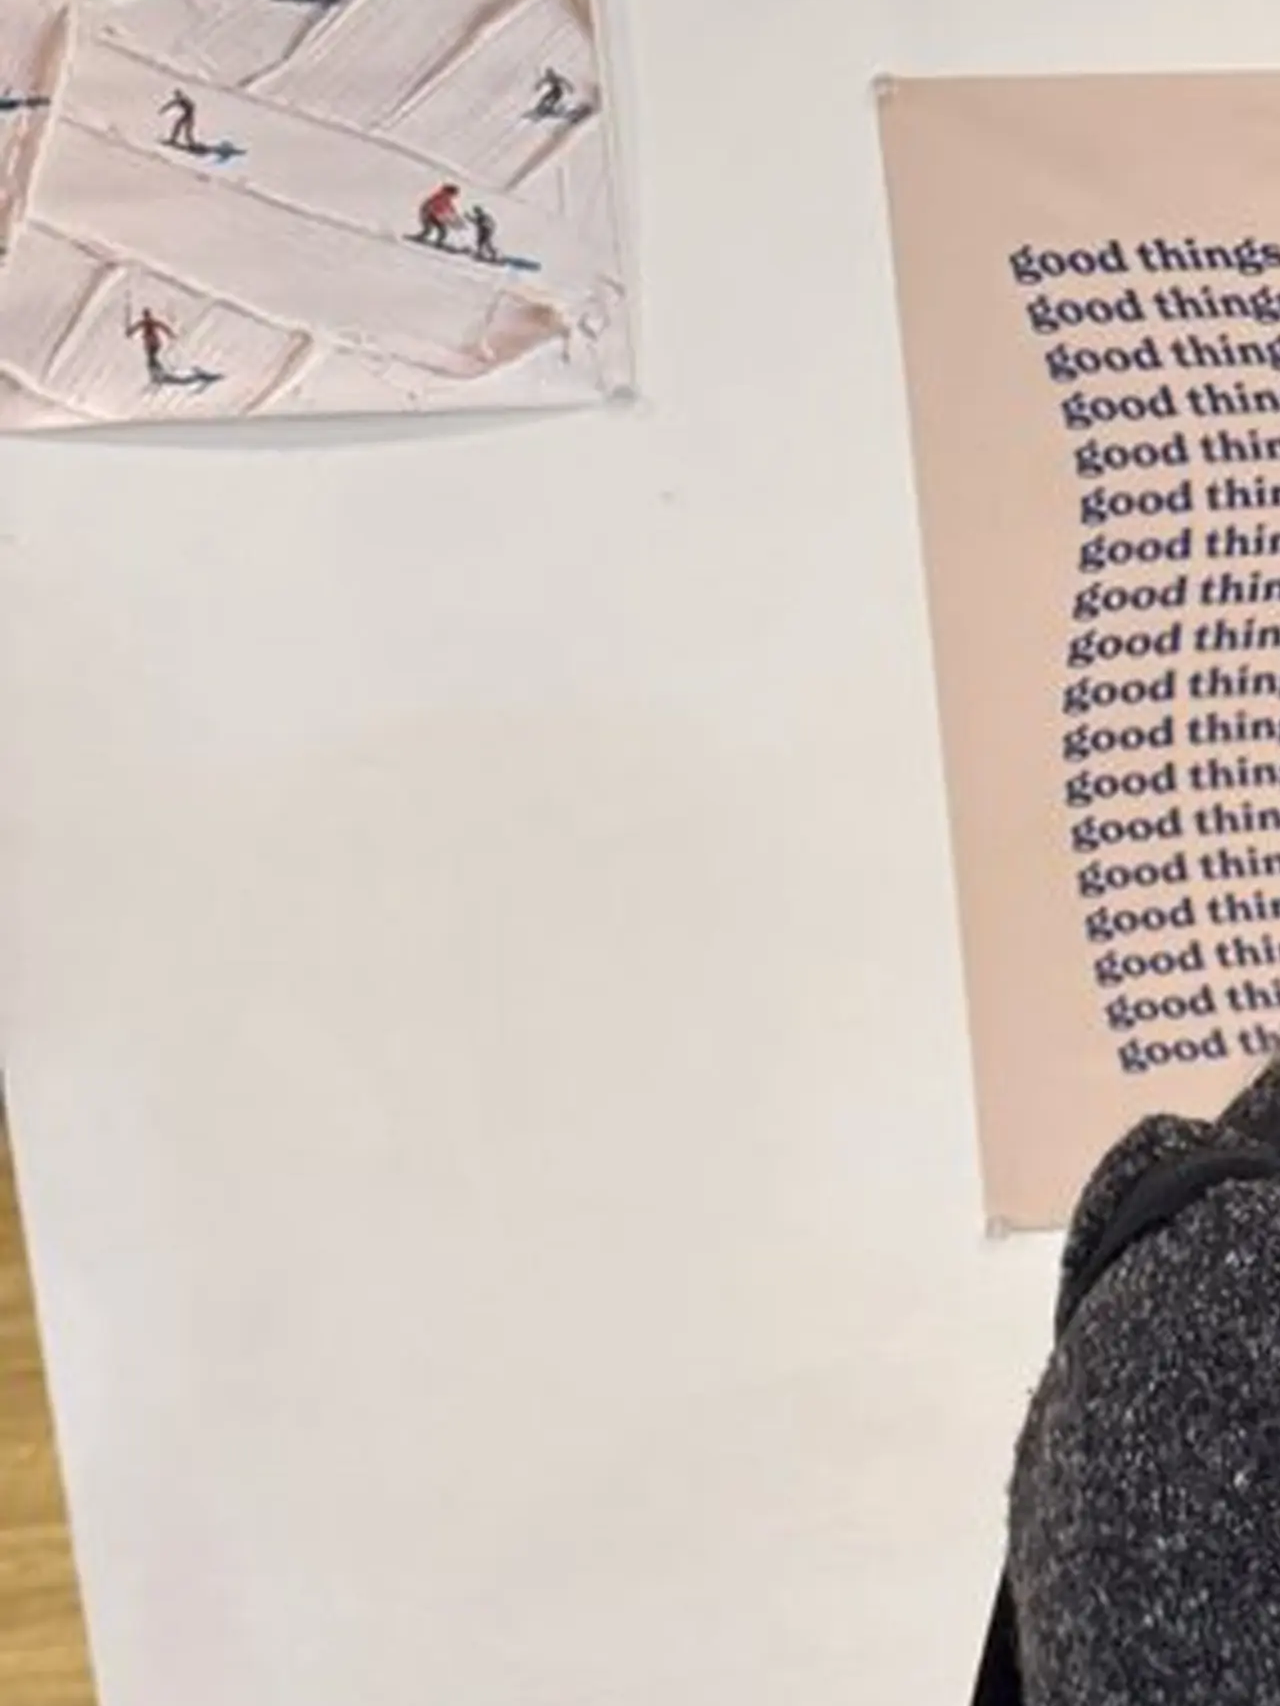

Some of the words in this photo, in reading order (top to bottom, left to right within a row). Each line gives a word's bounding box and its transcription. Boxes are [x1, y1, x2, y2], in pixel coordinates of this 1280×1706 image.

[1009, 240, 1130, 284] good
[1026, 289, 1146, 333] good
[1044, 337, 1163, 380] good
[1061, 385, 1178, 428] good
[1074, 433, 1190, 475] good
[1080, 481, 1193, 524] good
[1078, 528, 1192, 572] good
[1072, 576, 1188, 619] good
[1067, 623, 1182, 667] good
[1062, 670, 1176, 713] good
[1063, 716, 1174, 759] good
[1065, 762, 1177, 806] good
[1071, 808, 1183, 851] good
[1077, 853, 1188, 896] good
[1085, 898, 1196, 941] good
[1094, 941, 1205, 985] good
[1105, 985, 1216, 1028] good
[1118, 1030, 1228, 1073] good
